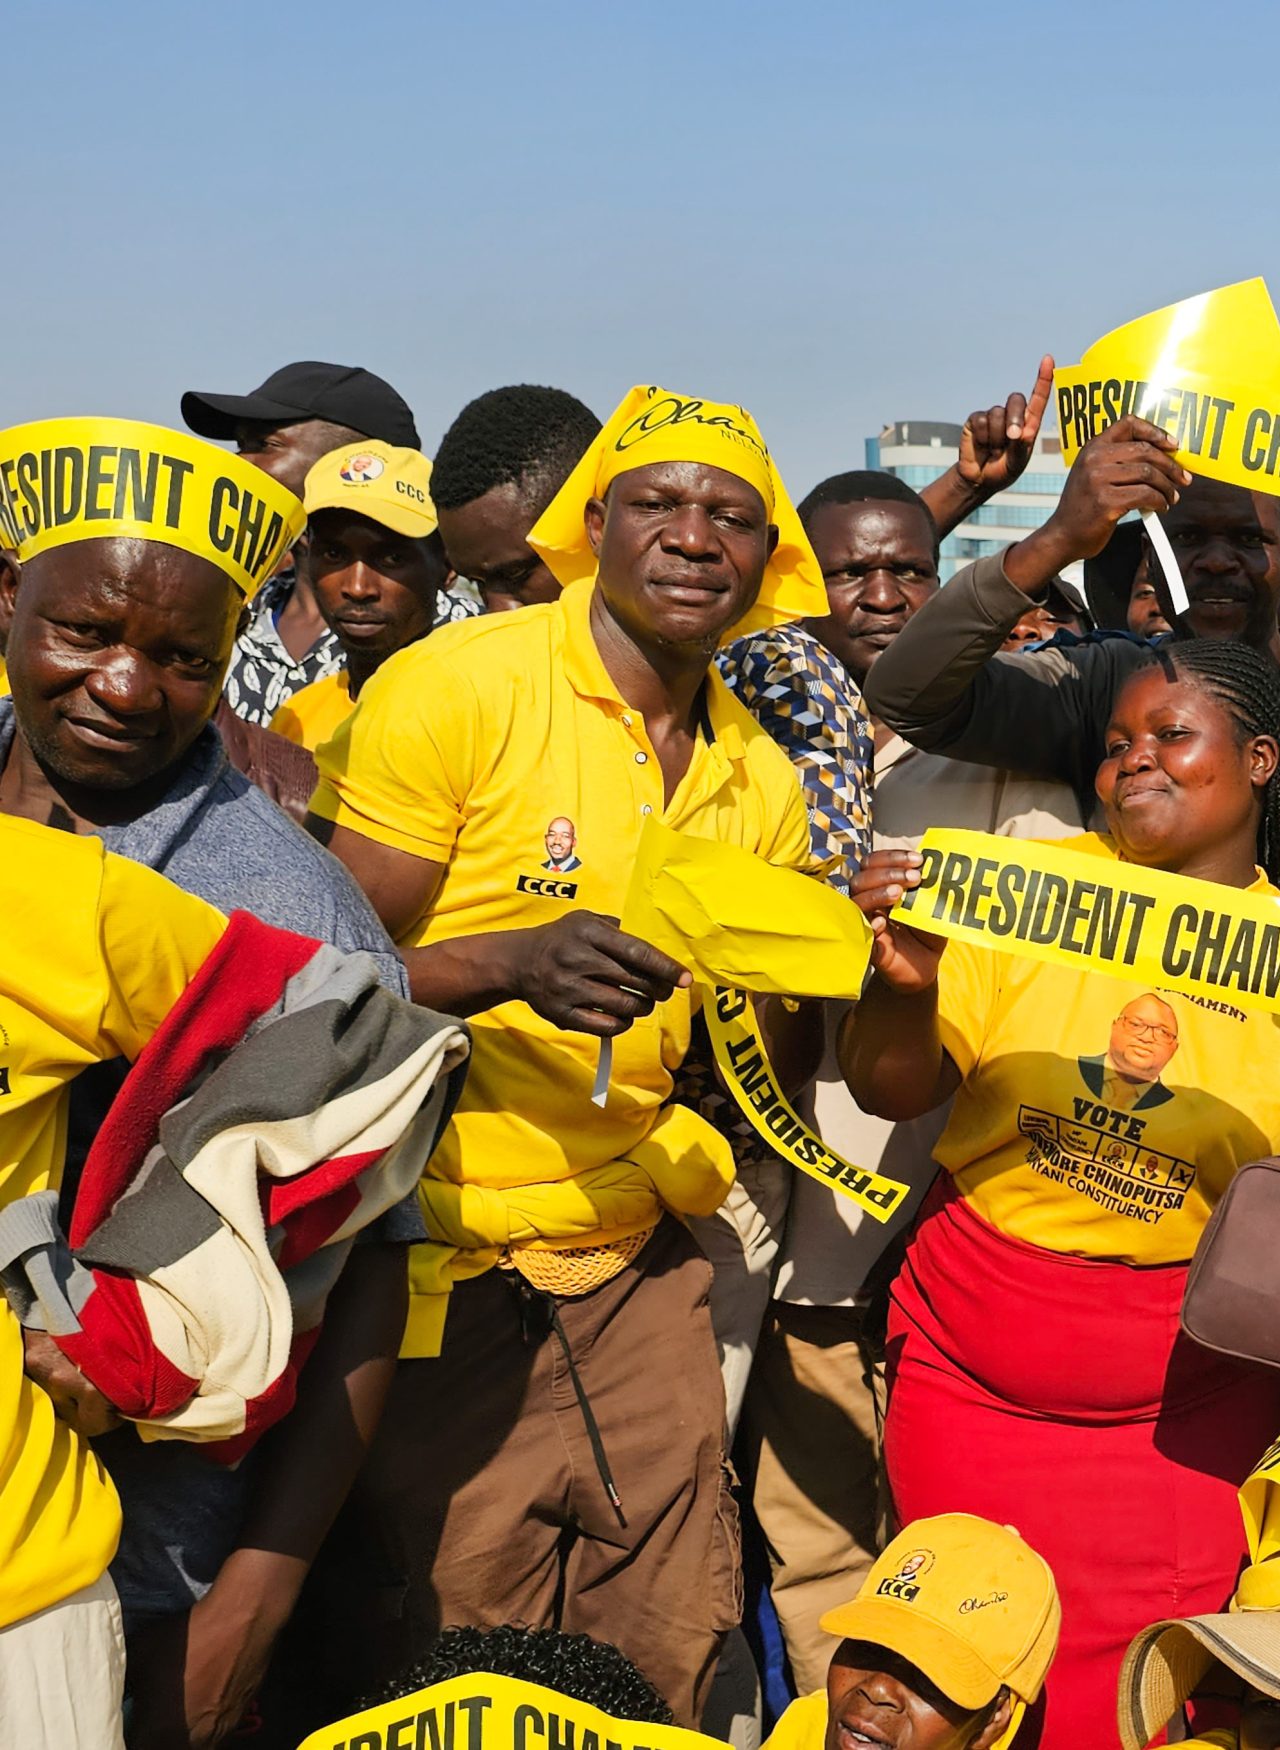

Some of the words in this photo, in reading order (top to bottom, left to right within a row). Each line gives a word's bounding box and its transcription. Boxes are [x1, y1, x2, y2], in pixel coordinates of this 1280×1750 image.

[396, 480, 425, 503] CCC
[209, 476, 290, 578] CHA
[524, 878, 572, 898] CCC
[901, 848, 1155, 966] PRESIDENT
[726, 1034, 899, 1209] PRESIDENT
[1072, 1096, 1147, 1142] VOTE
[1067, 1175, 1165, 1225] CONSTITUENCY
[1083, 1163, 1185, 1210] CHINOPUTSA
[880, 1579, 916, 1600] CCC
